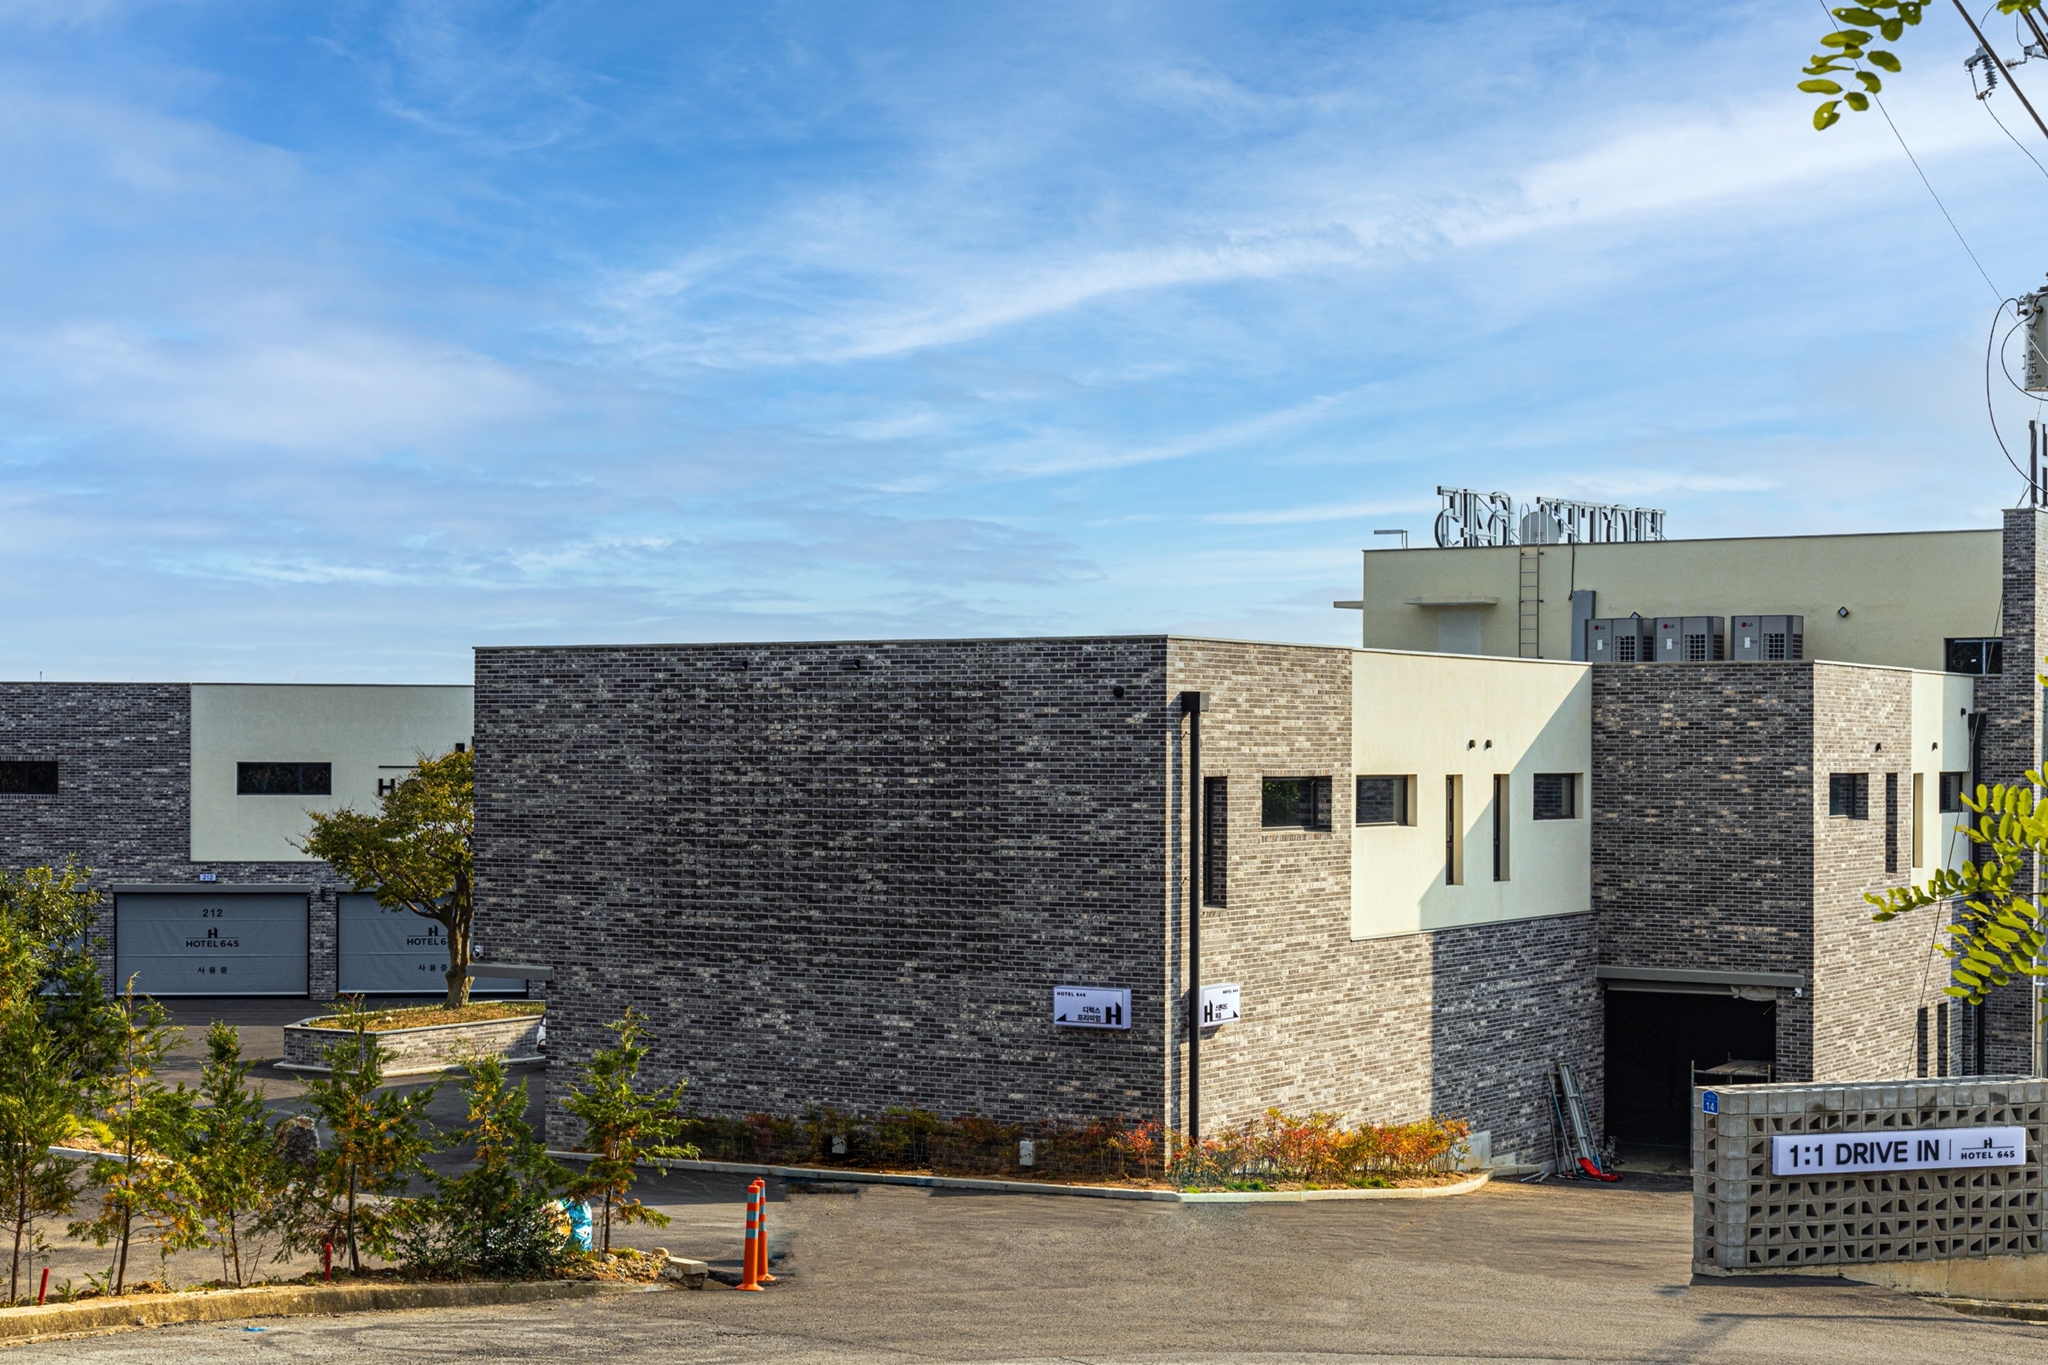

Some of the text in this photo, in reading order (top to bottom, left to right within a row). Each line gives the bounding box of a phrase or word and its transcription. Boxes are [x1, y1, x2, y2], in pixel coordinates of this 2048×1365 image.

[202, 908, 223, 918] 212
[185, 940, 240, 948] HOTEL 645
[406, 938, 440, 946] HOTEL
[1706, 1101, 1715, 1112] 14
[1789, 1139, 1940, 1168] 1:1 DRIVE IN
[1960, 1150, 2015, 1160] HOTEL 645
